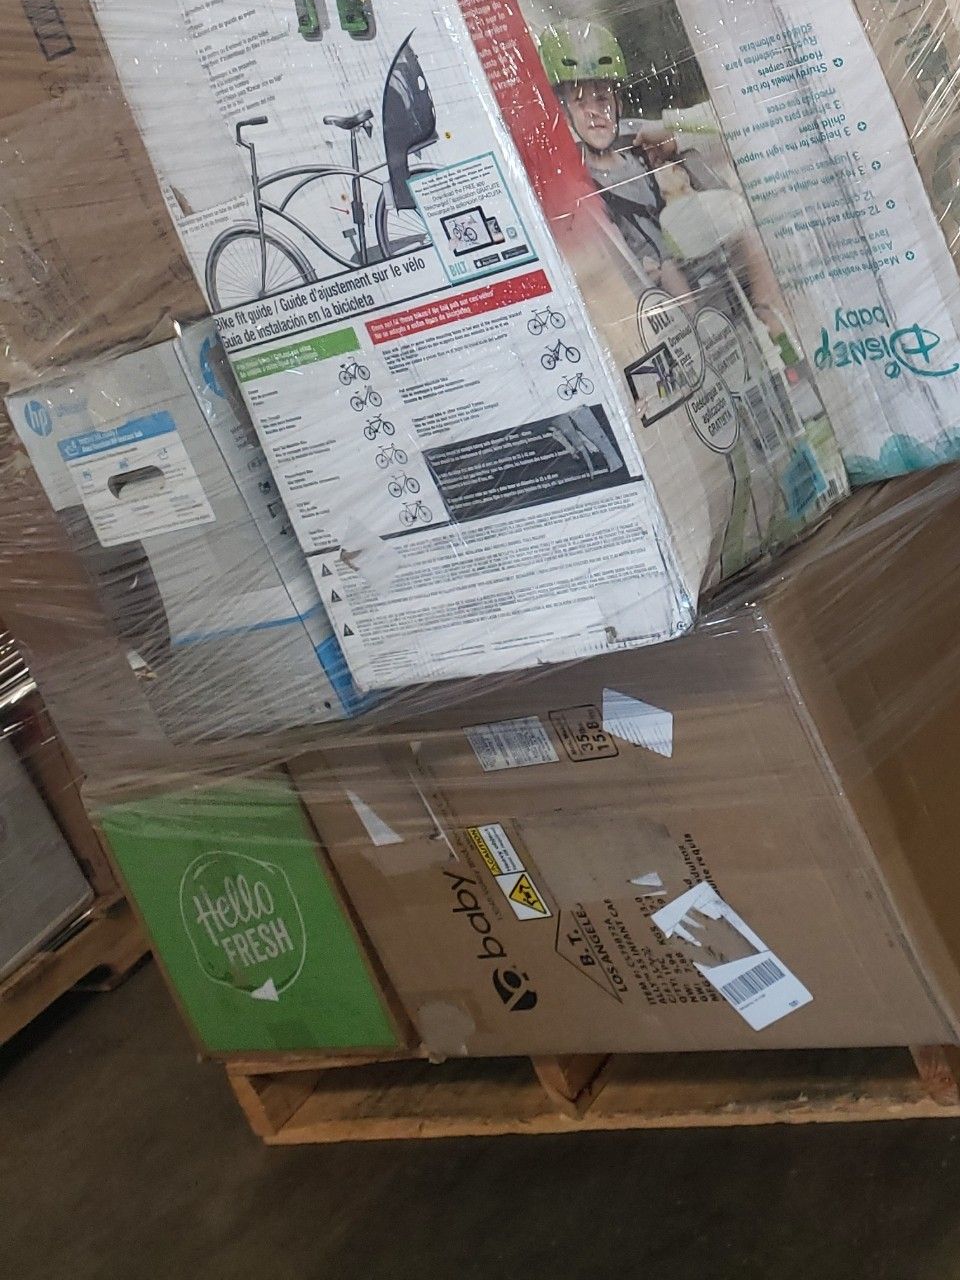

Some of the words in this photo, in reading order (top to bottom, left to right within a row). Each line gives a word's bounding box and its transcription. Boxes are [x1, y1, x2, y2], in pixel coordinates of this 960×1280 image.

[757, 60, 784, 76] carpets
[794, 61, 828, 79] Sturdy
[740, 83, 759, 96] bare
[759, 80, 770, 91] for
[832, 99, 841, 109] 3
[820, 113, 846, 129] child
[842, 125, 851, 136] 3
[784, 141, 798, 152] the
[798, 138, 810, 148] for
[852, 151, 860, 160] 3
[857, 165, 865, 175] 3
[867, 203, 881, 215] 12
[213, 312, 234, 331] Bike
[234, 310, 246, 324] fit
[247, 303, 272, 325] guide
[279, 291, 307, 311] Guide
[308, 273, 371, 303] d'ajustement
[372, 269, 389, 284] sur
[389, 263, 401, 278] le
[402, 255, 426, 274] vélo
[242, 328, 255, 342] de
[256, 311, 307, 339] instalación
[308, 310, 321, 324] en
[321, 305, 332, 319] la
[332, 292, 373, 316] bicicleta
[831, 303, 889, 335] baby
[815, 323, 959, 378] Disney
[470, 829, 494, 864] CAUTION
[682, 832, 706, 866] requis
[191, 873, 273, 946] Hello
[443, 872, 507, 956] baby
[220, 916, 293, 966] FRESH
[614, 919, 638, 956] INFANT
[606, 965, 627, 992] LOS
[639, 981, 656, 1006] ITEM
